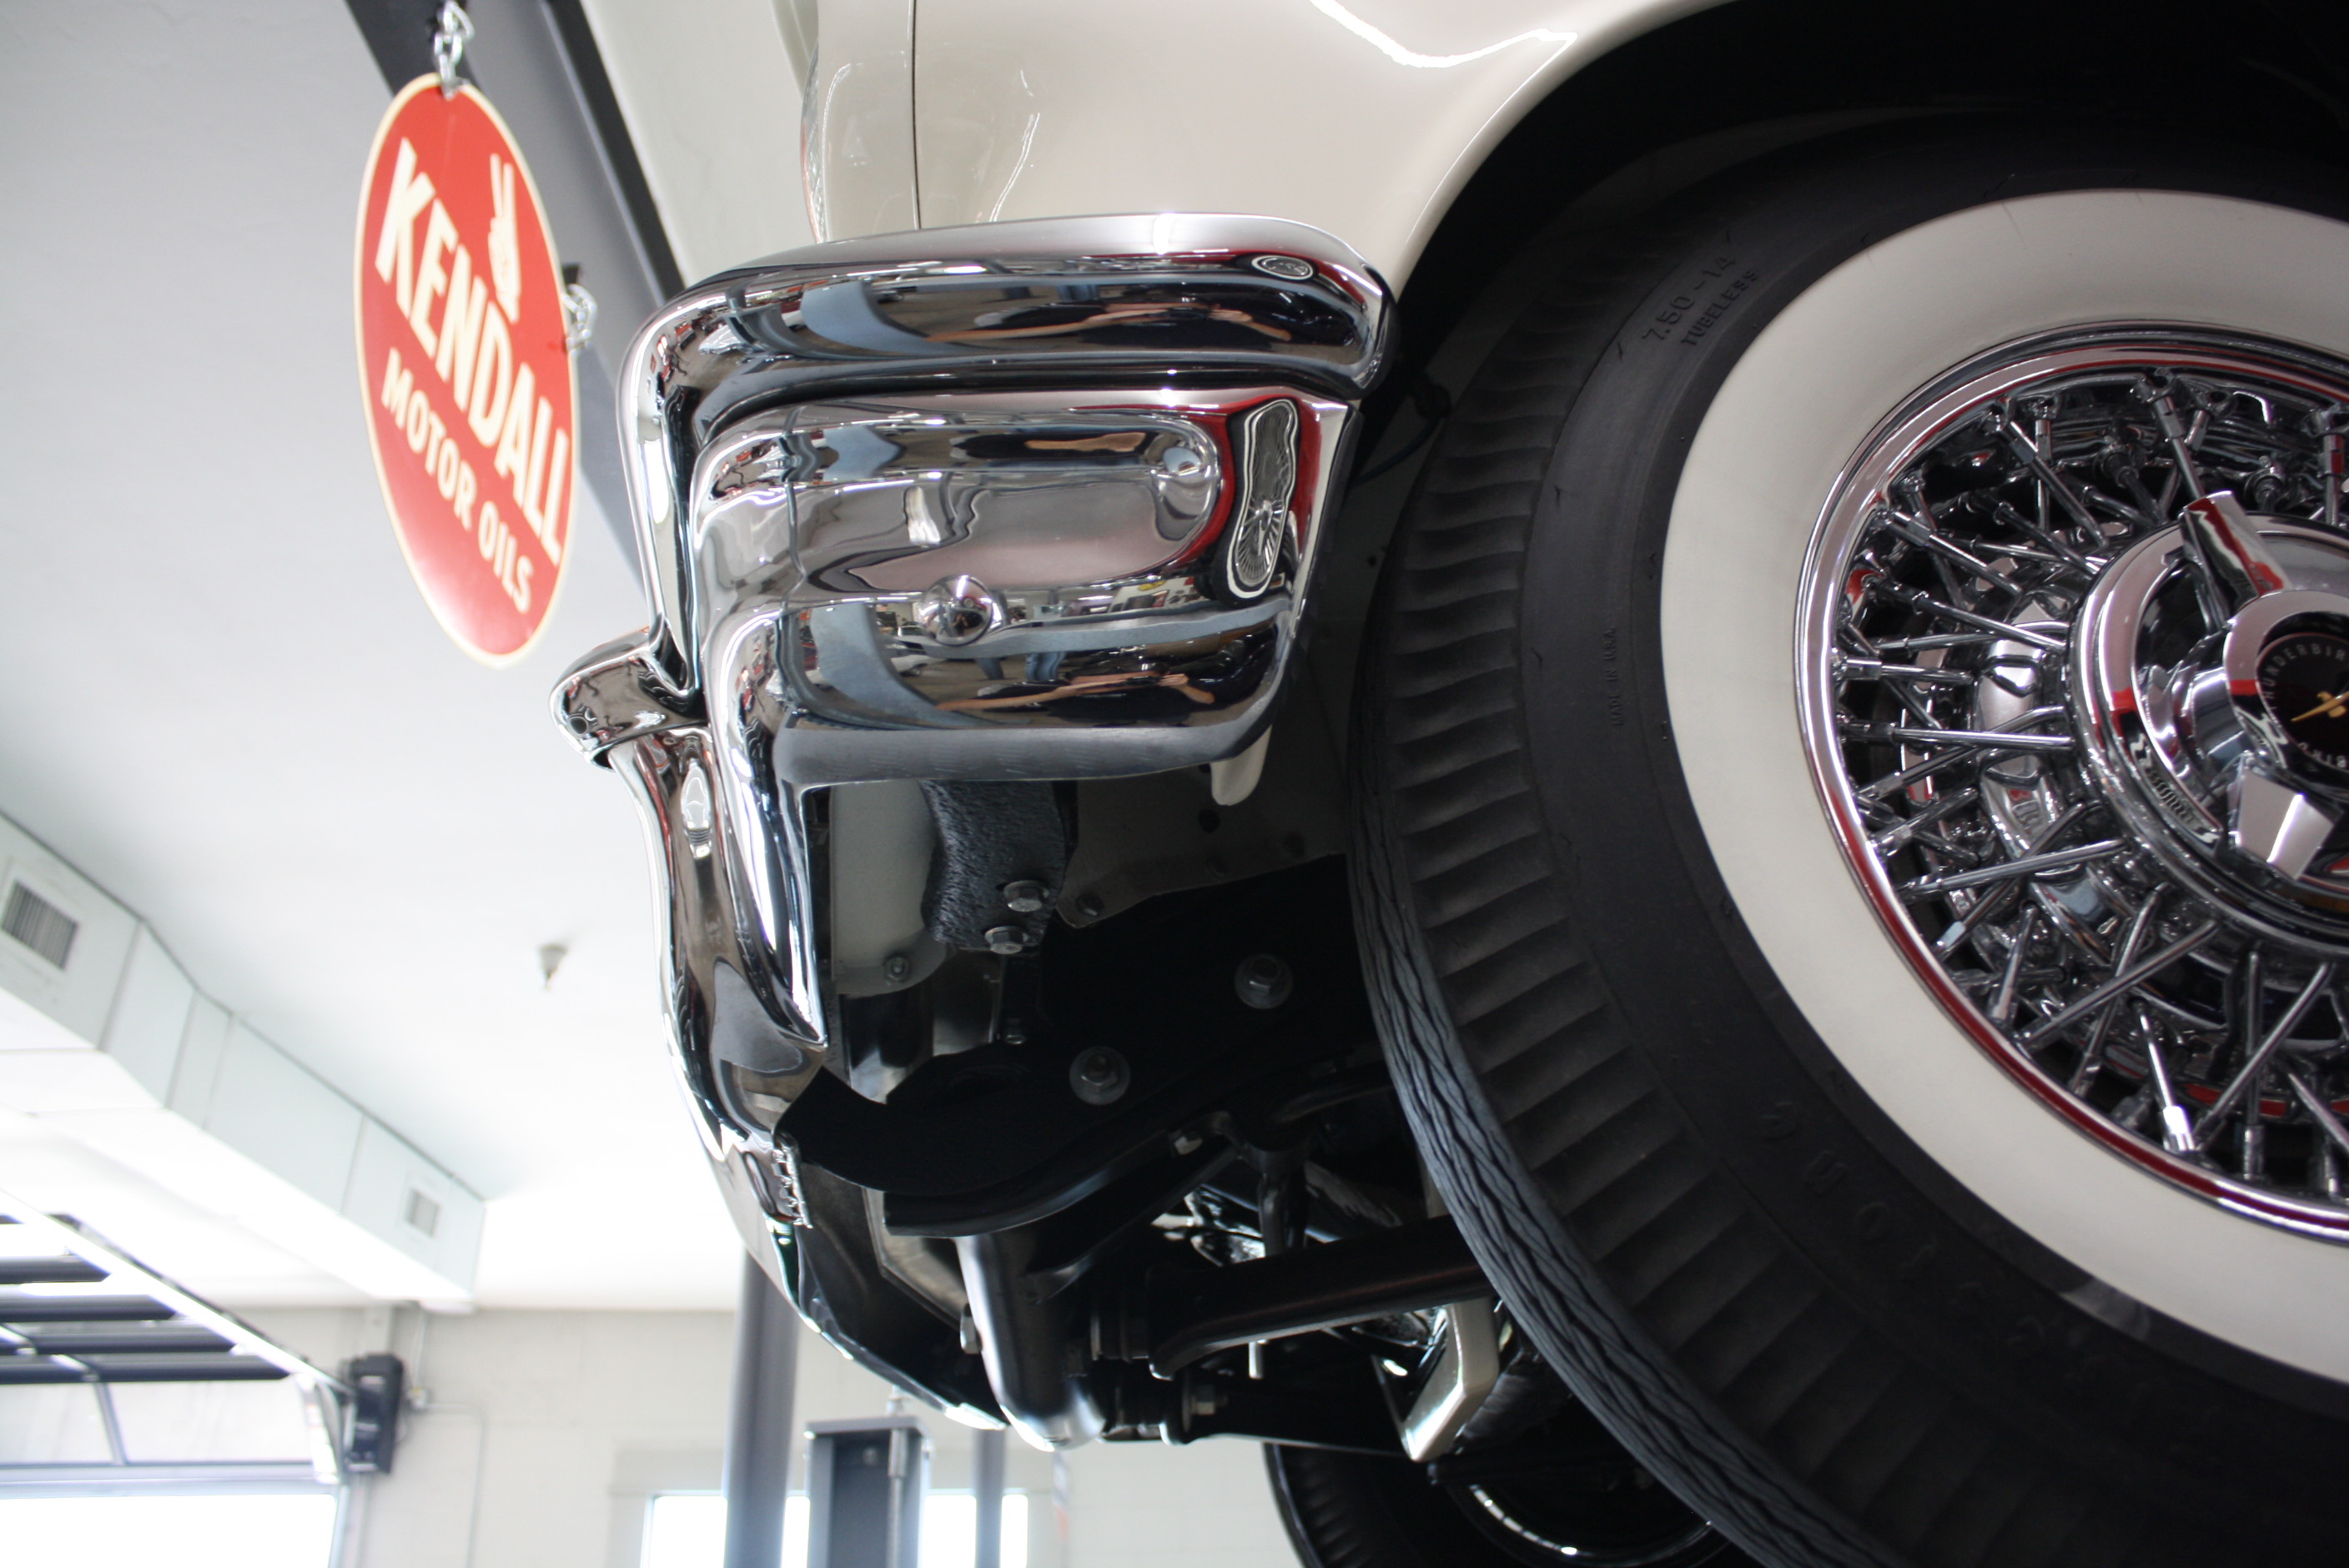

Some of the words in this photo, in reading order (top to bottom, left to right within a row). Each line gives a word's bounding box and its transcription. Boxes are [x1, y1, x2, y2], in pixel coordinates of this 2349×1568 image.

[375, 137, 570, 566] KENDALL
[1680, 270, 1758, 346] TUBELESS
[380, 346, 477, 532] MOTOR
[477, 500, 534, 615] OILS
[1604, 666, 1617, 682] IN
